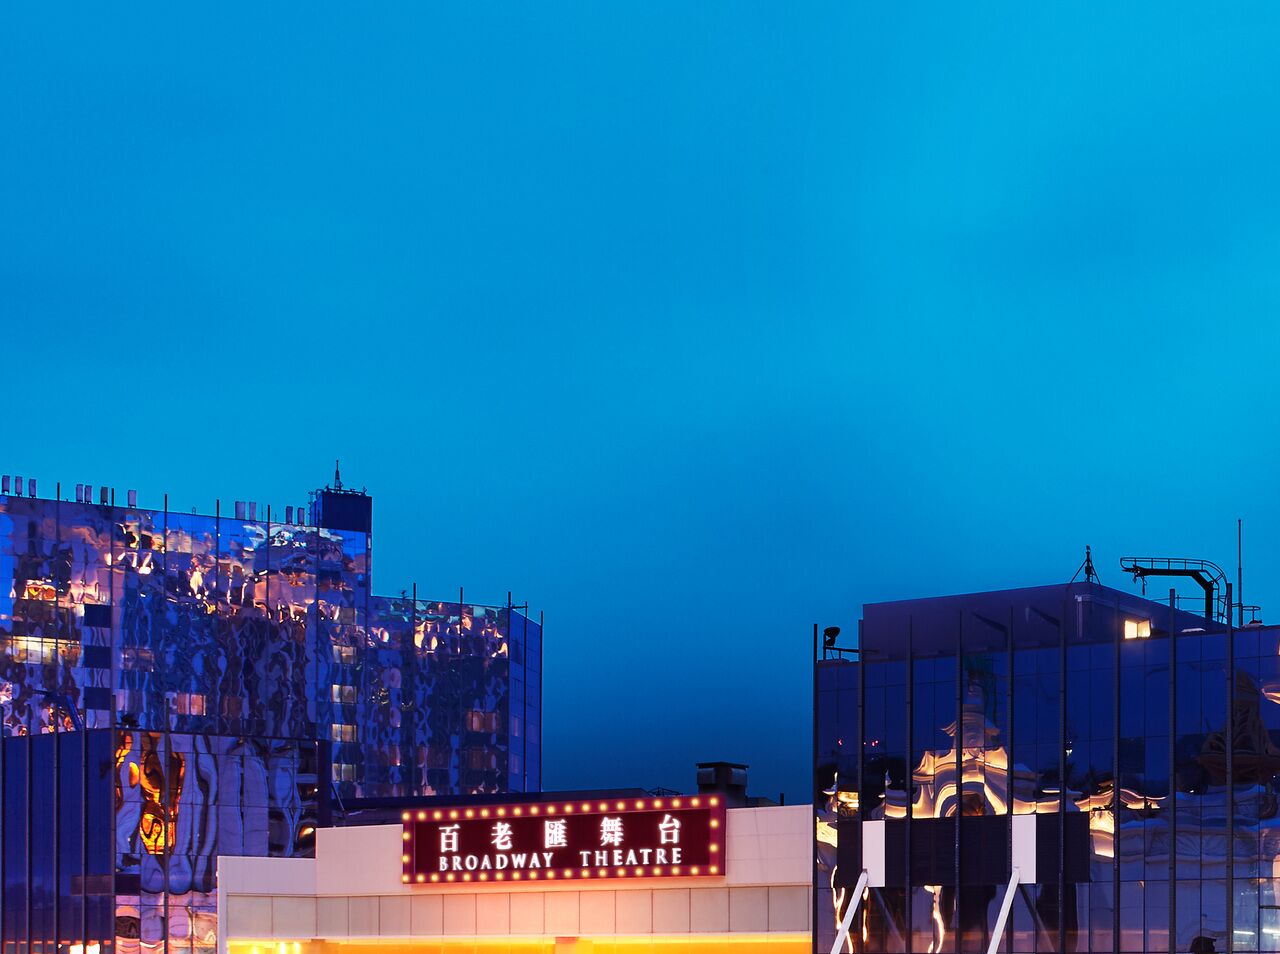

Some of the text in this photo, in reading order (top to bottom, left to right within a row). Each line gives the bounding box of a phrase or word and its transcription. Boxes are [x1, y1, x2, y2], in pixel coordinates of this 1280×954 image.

[438, 814, 681, 853] 百老匯舞台
[438, 847, 682, 872] BROADWAY THEATRE
